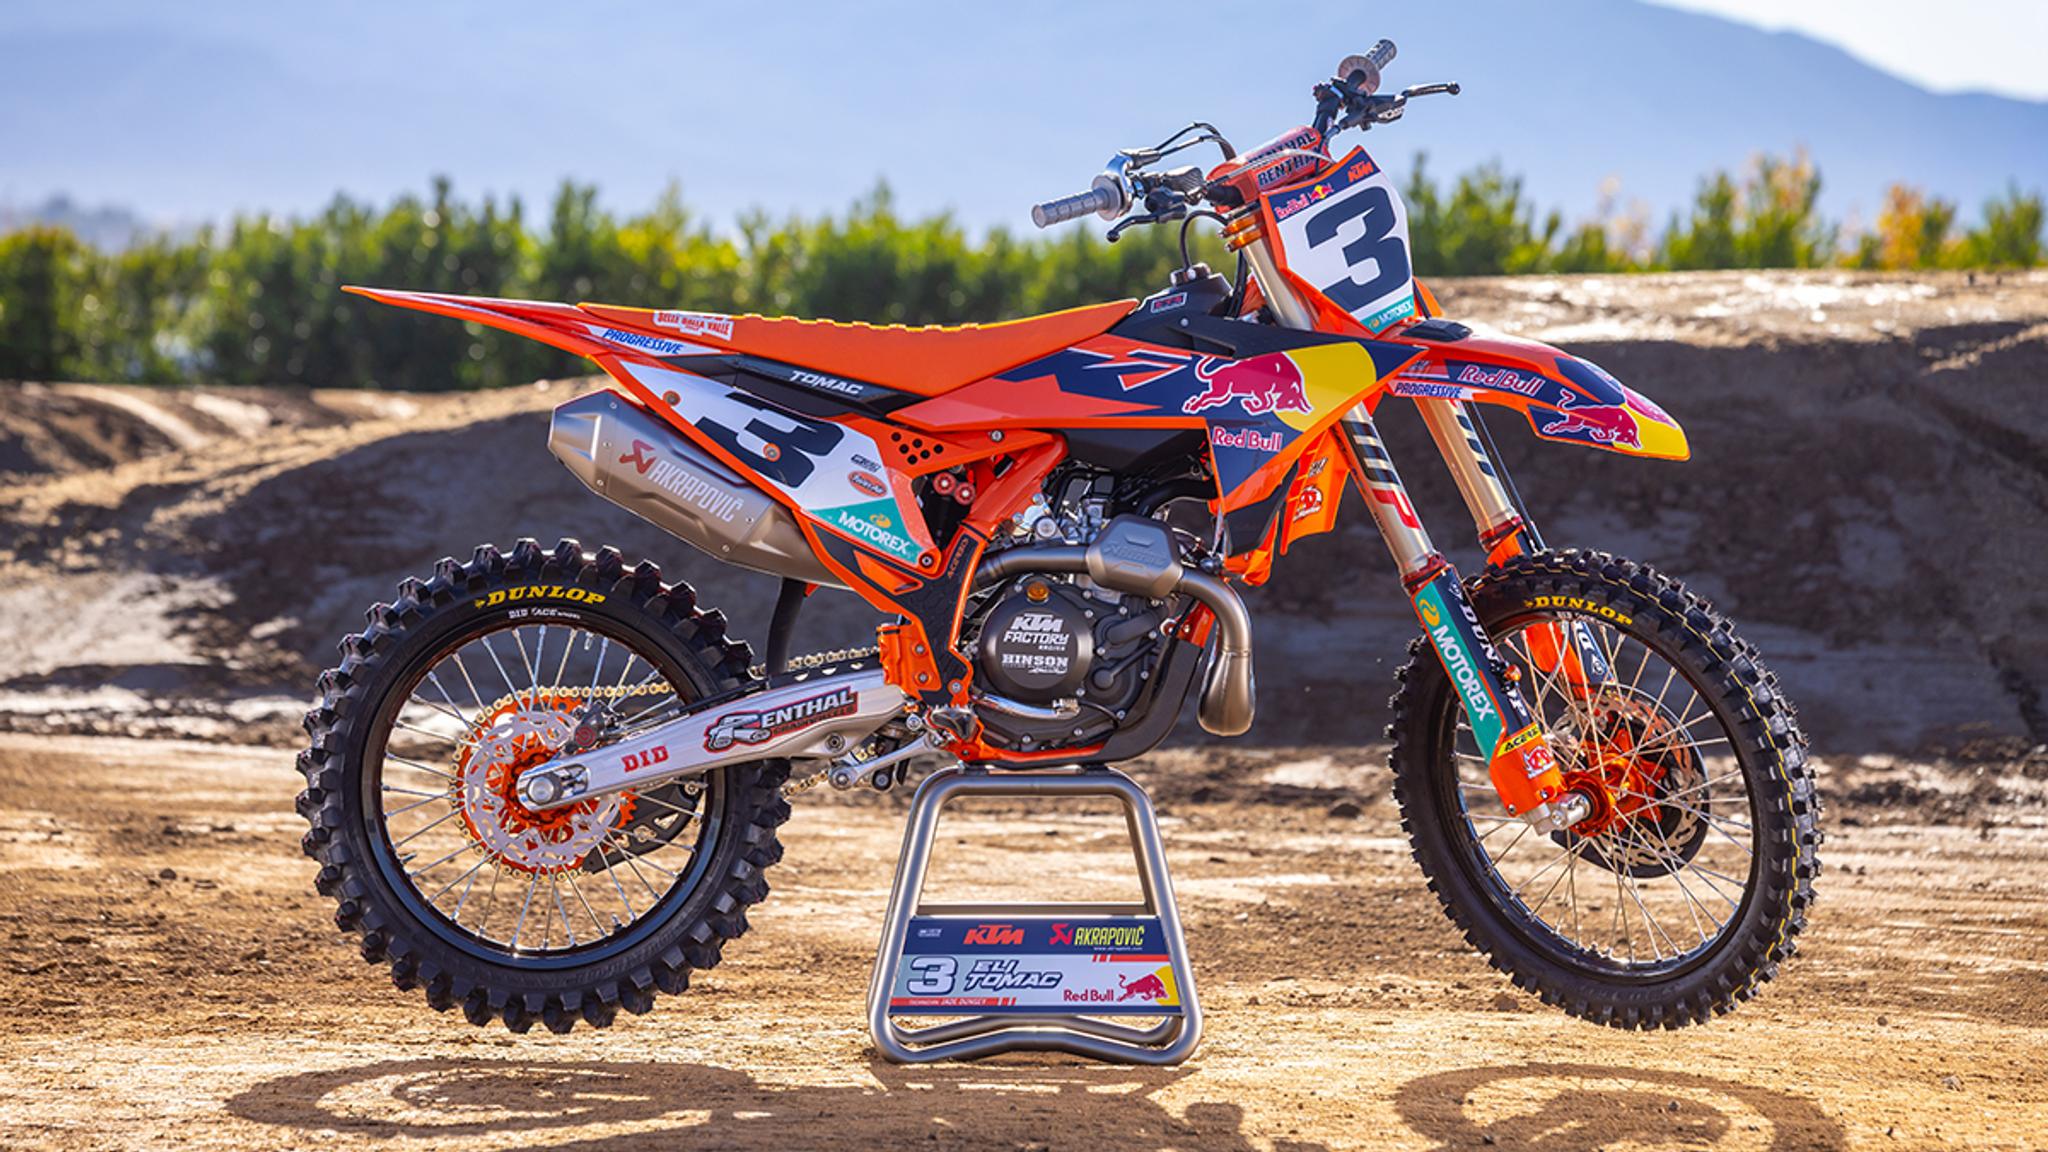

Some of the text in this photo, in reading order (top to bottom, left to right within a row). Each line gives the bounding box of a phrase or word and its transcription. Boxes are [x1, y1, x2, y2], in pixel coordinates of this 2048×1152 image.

[1347, 161, 1374, 183] KTM
[1305, 186, 1410, 313] 3
[602, 328, 685, 355] PROGRESSIVE
[789, 370, 864, 395] TOMAC
[1394, 382, 1463, 398] PROGRESSIVE
[1458, 365, 1502, 386] Red
[1498, 369, 1546, 396] Bull
[694, 391, 845, 488] 3
[1212, 427, 1283, 451] Red Bull
[838, 510, 911, 555] MOTOREX
[486, 585, 606, 608] DUNLOP
[1534, 596, 1633, 625] DUNLOP
[1010, 613, 1064, 633] KTM
[1003, 630, 1070, 645] FACTORY
[1001, 653, 1069, 668] HINSON
[1433, 624, 1495, 722] MOTOREX
[621, 746, 670, 774] DID
[963, 924, 1025, 945] KTM
[906, 956, 1020, 997] 3 ELI
[963, 971, 1064, 992] TOMAC
[1063, 989, 1115, 1002] Red Bull
